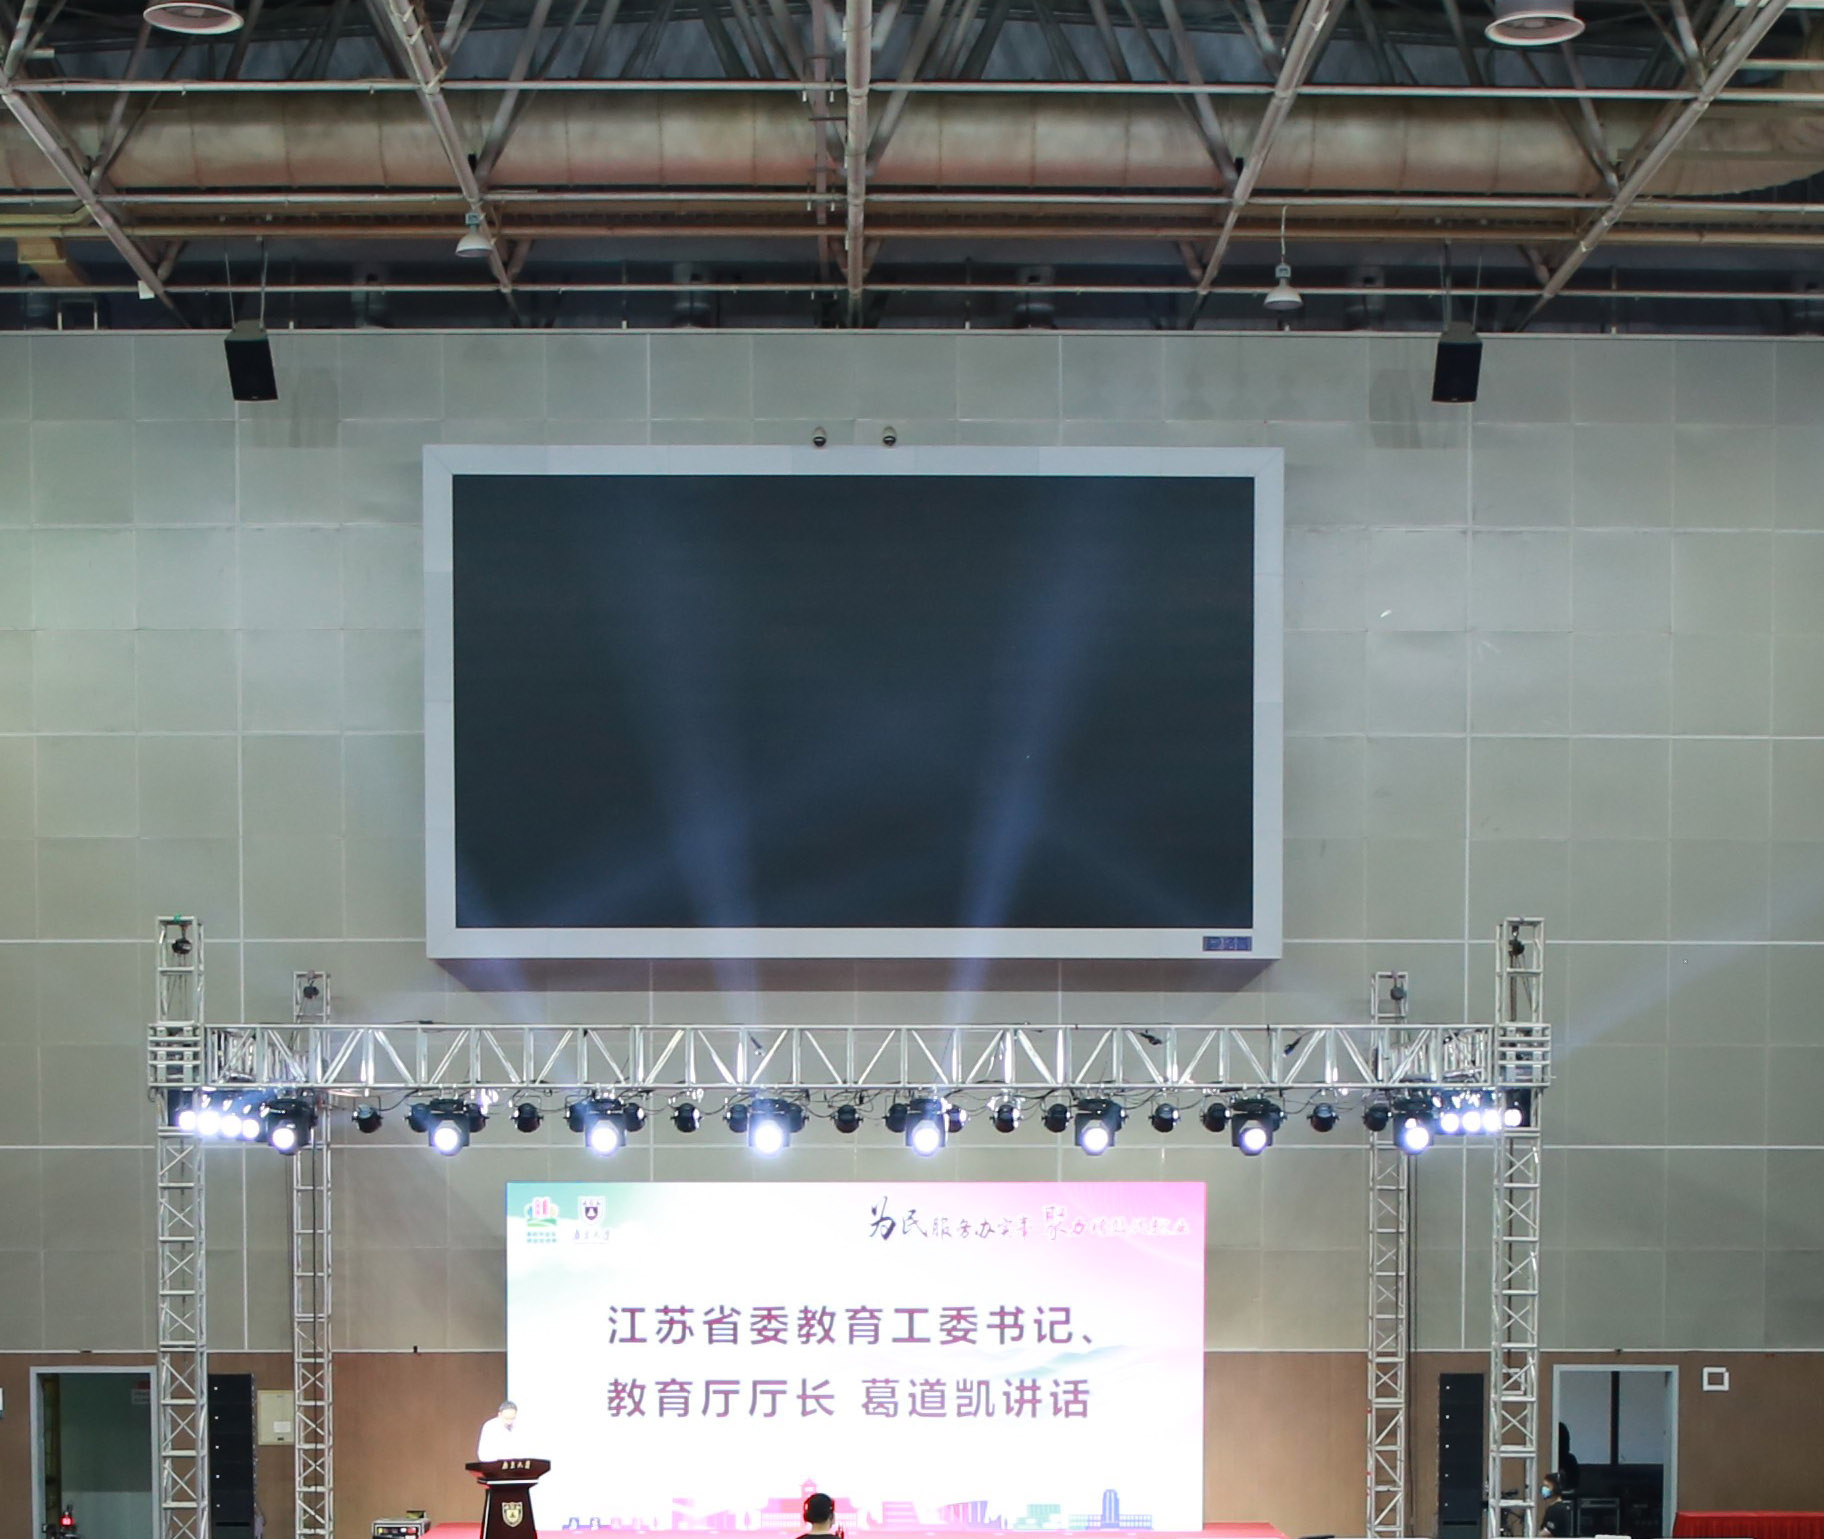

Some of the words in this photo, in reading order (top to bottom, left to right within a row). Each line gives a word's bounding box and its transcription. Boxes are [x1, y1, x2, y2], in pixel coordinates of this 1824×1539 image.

[607, 1305, 1096, 1345] 江苏省委教育工委书记、
[607, 1378, 835, 1418] 教育厅厅长
[861, 1377, 1090, 1418] 葛道凯讲话
